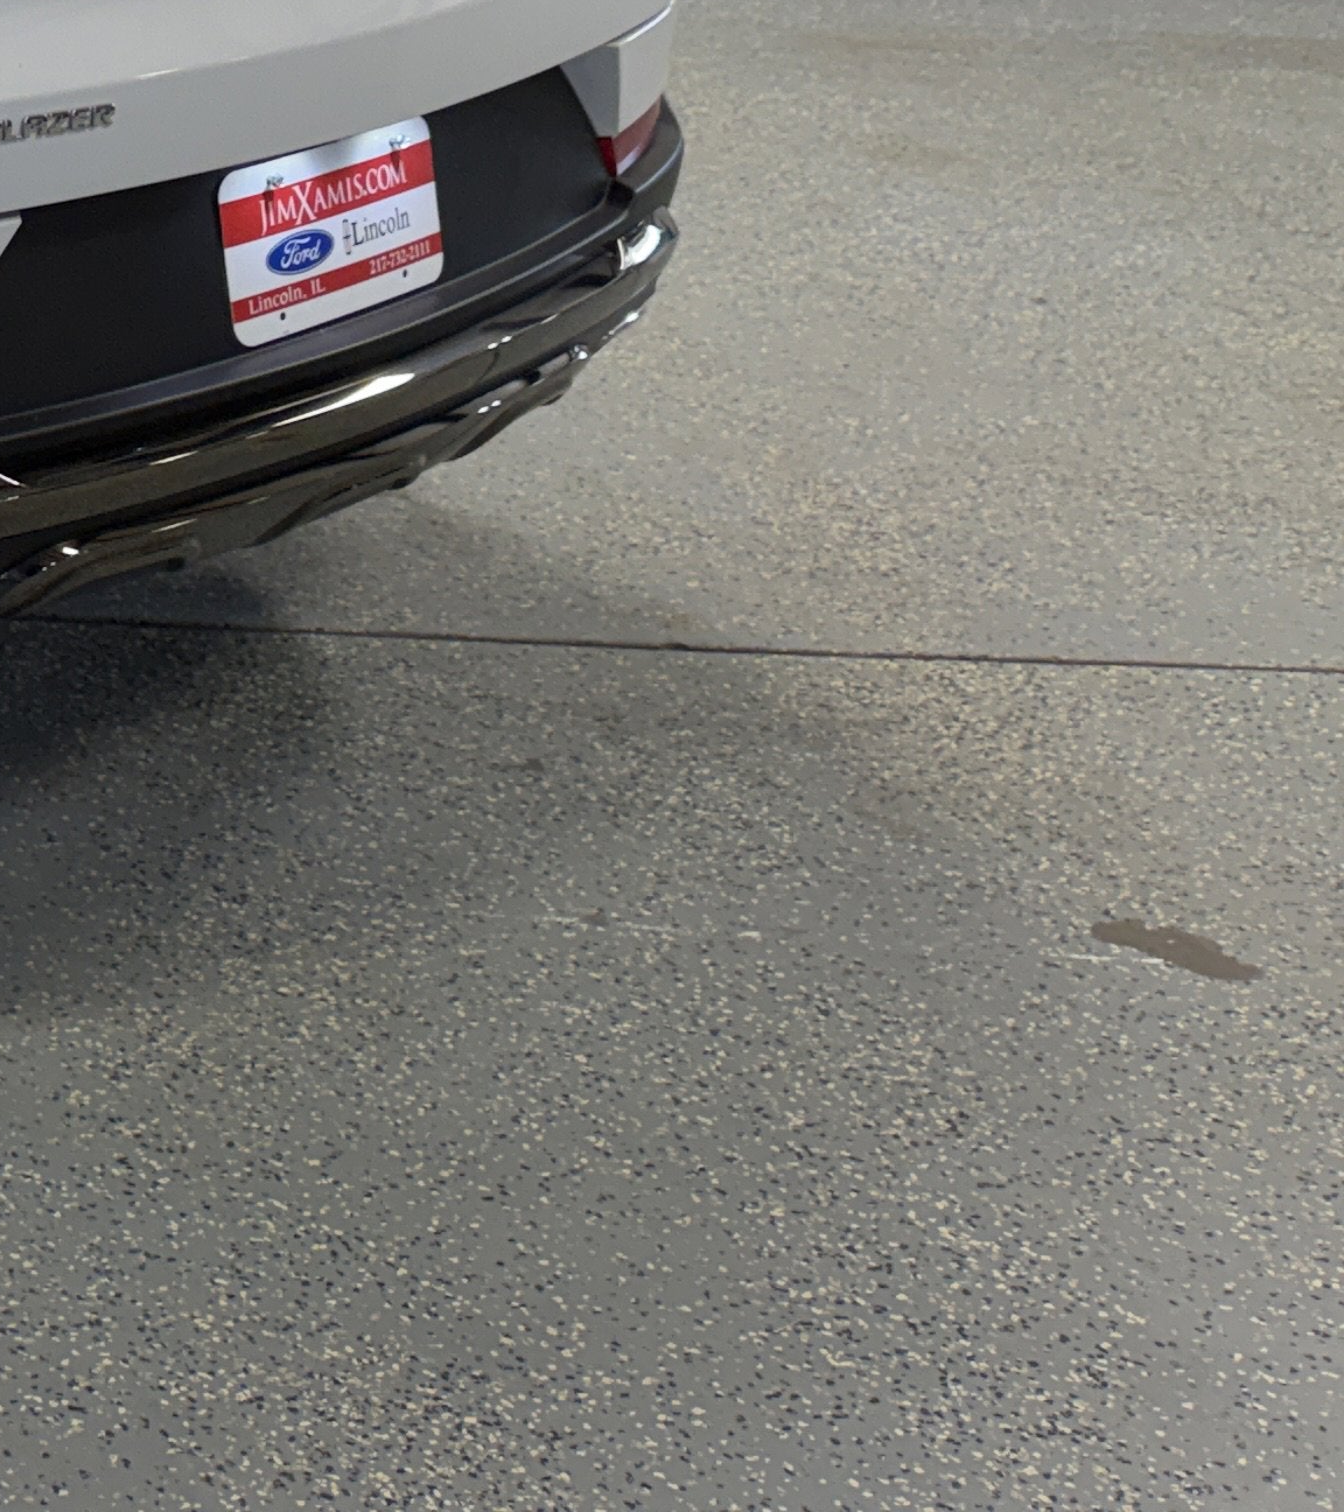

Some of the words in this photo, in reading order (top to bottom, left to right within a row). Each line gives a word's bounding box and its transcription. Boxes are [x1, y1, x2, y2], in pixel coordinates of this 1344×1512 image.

[259, 160, 408, 235] JIMXAMIS.COM
[351, 208, 410, 246] Lincoln
[280, 236, 320, 269] Ford
[369, 241, 430, 275] 217-732-2111
[310, 278, 326, 294] IL
